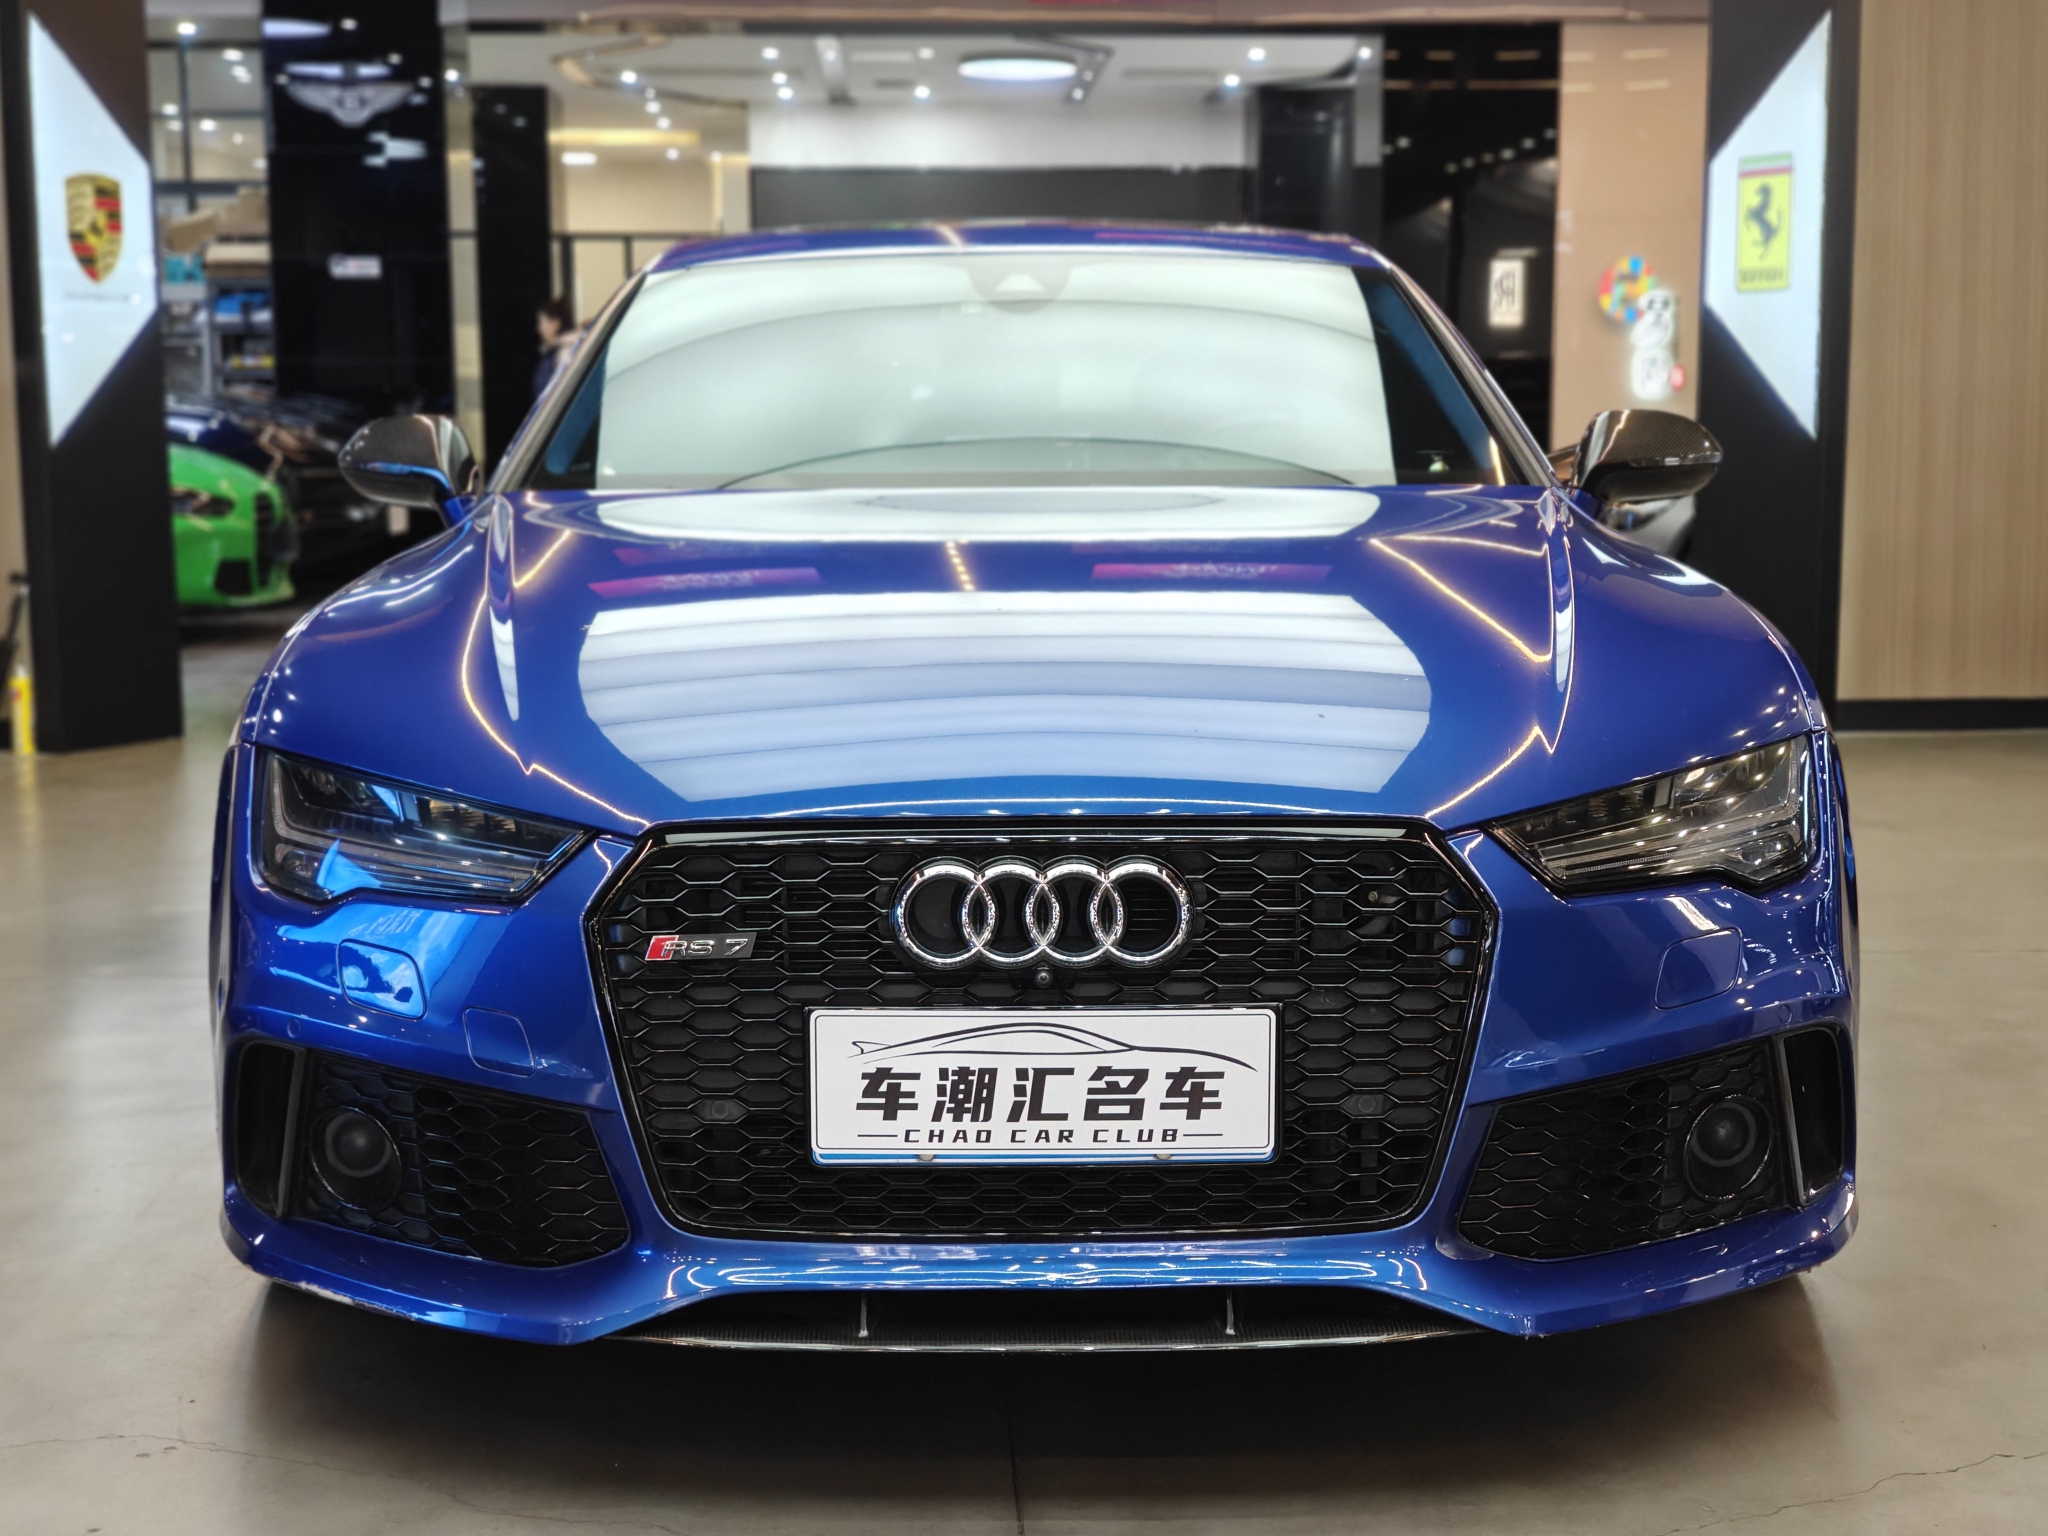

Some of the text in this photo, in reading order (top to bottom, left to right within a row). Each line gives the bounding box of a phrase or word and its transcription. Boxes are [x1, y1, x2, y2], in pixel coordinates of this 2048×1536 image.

[855, 1065, 1226, 1123] 车潮汇名车
[903, 1128, 1178, 1144] CHAO CAR CLUB
